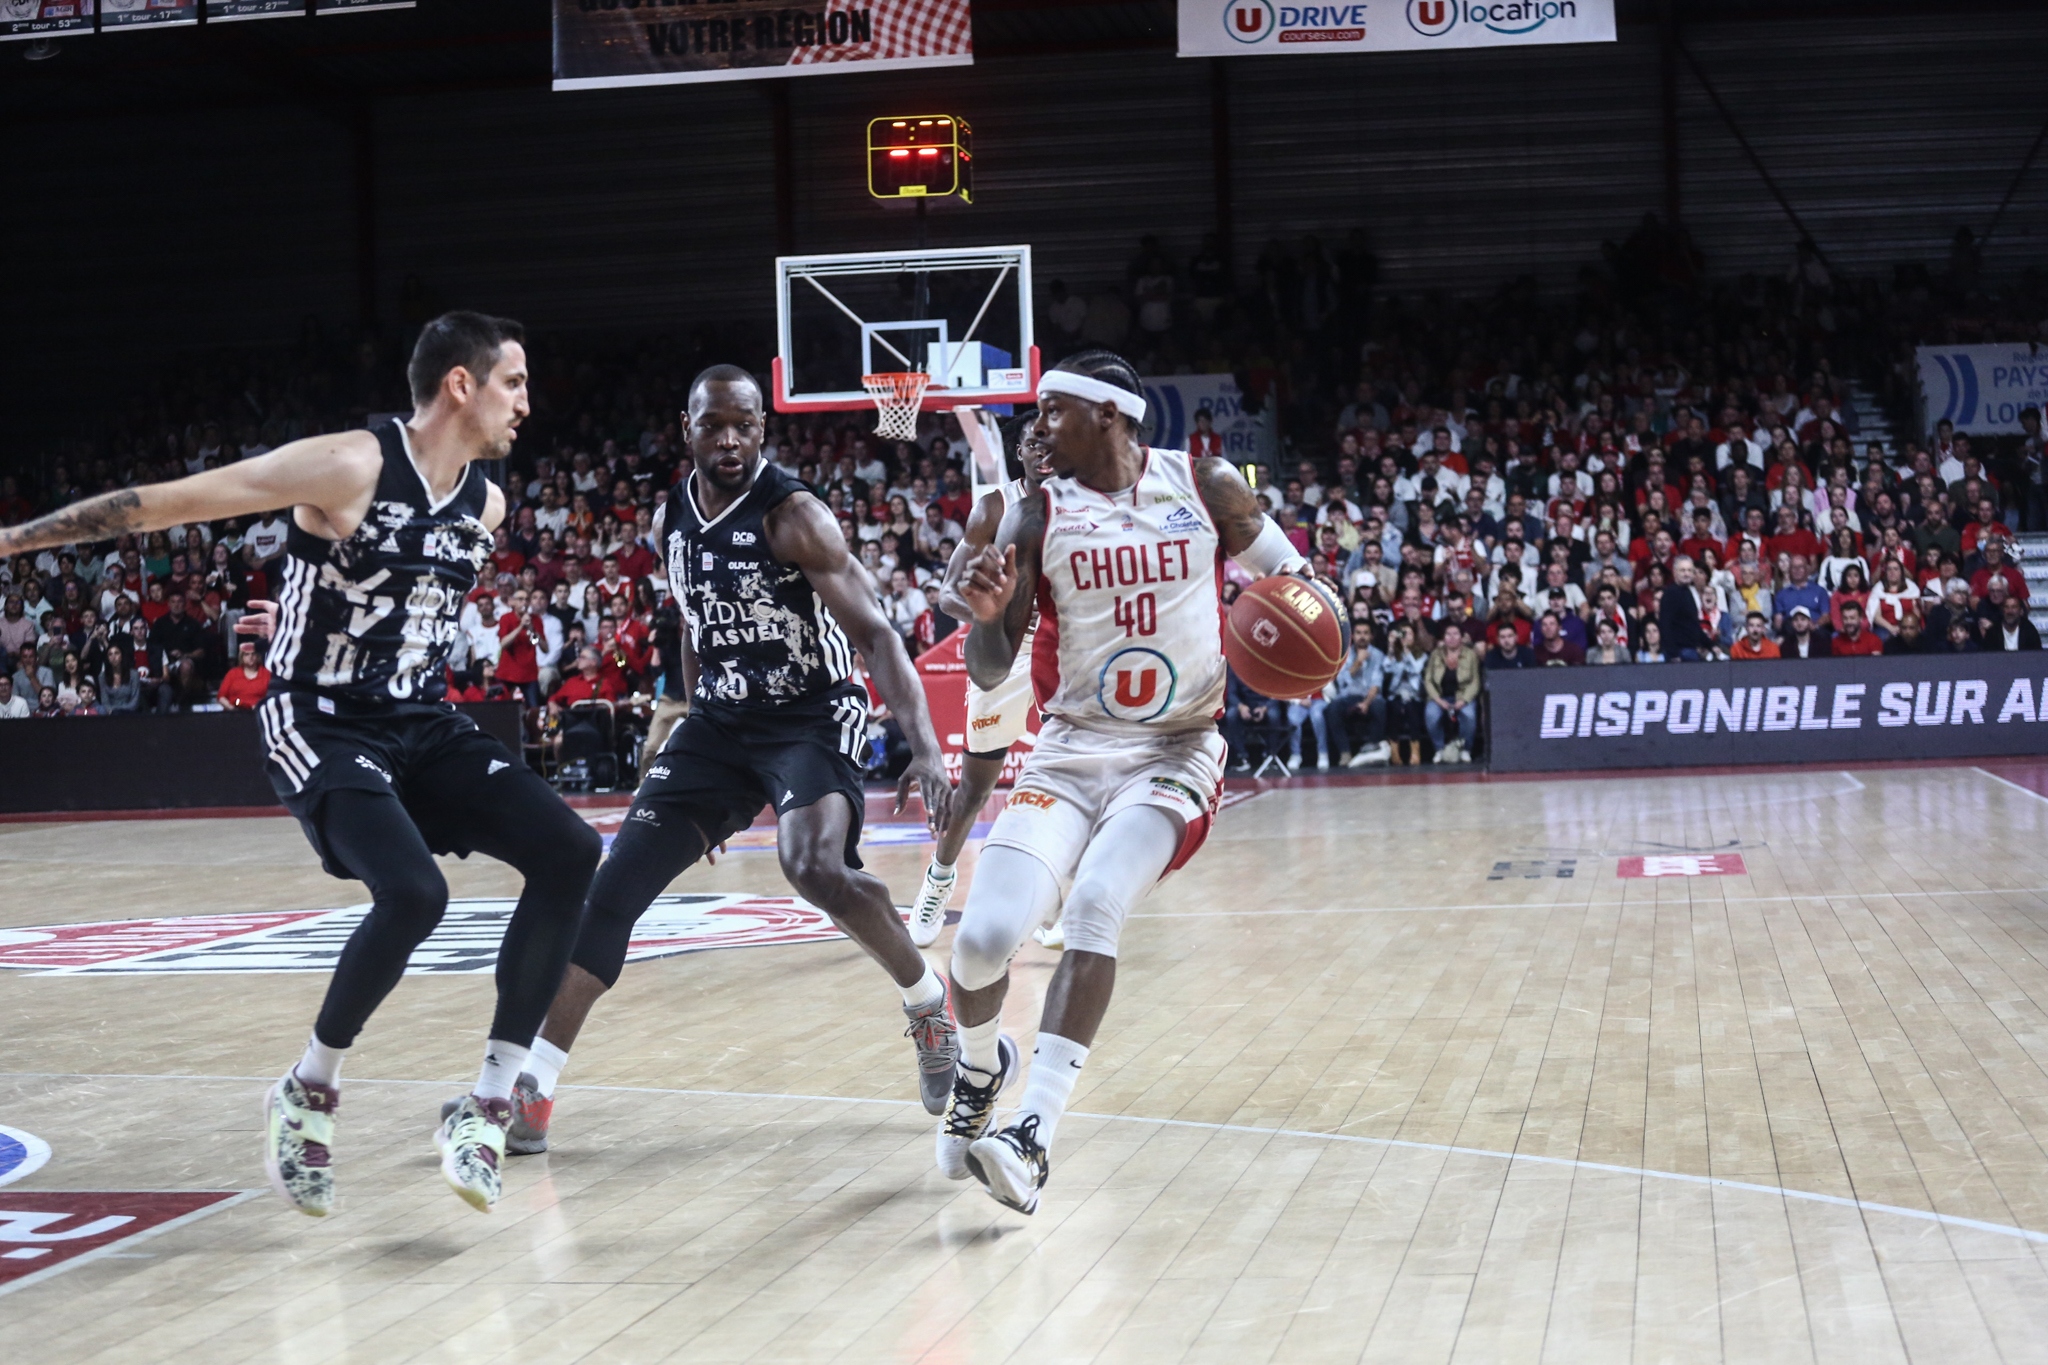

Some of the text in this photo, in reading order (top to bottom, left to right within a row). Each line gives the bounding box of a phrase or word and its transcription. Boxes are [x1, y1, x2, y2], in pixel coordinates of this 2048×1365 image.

[1236, 5, 1367, 33] U DRIVE
[1463, 0, 1577, 24] location
[647, 18, 748, 57] VOTRE
[1283, 29, 1362, 42] coursesu.com
[1070, 539, 1190, 591] CHOLET
[702, 598, 777, 625] LDLC
[1114, 592, 1157, 637] 40
[1283, 585, 1323, 621] LNB
[712, 623, 785, 647] ASVEL
[1114, 668, 1157, 708] U
[1540, 677, 2048, 739] DISPONIBLE SUR A
